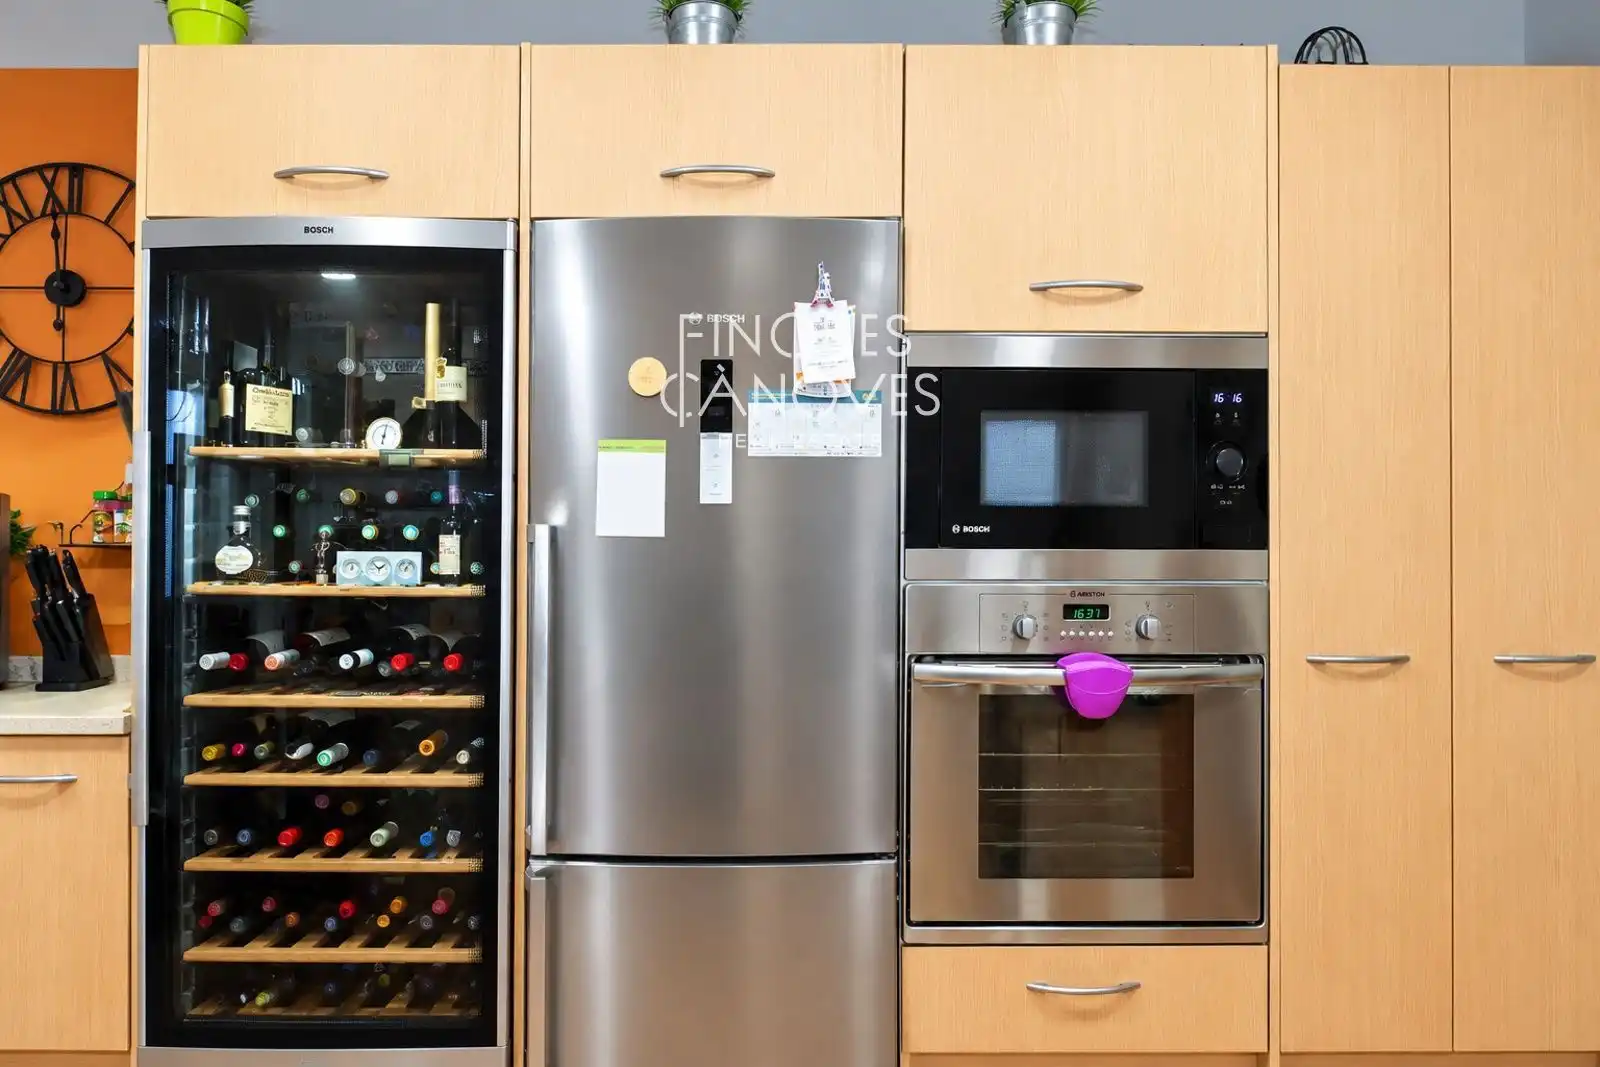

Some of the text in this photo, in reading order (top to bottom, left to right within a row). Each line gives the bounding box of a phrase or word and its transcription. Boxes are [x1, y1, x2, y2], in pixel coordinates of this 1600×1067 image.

[303, 226, 335, 235] BOSCH
[706, 313, 746, 324] BOSCH
[963, 525, 990, 533] BOSCH
